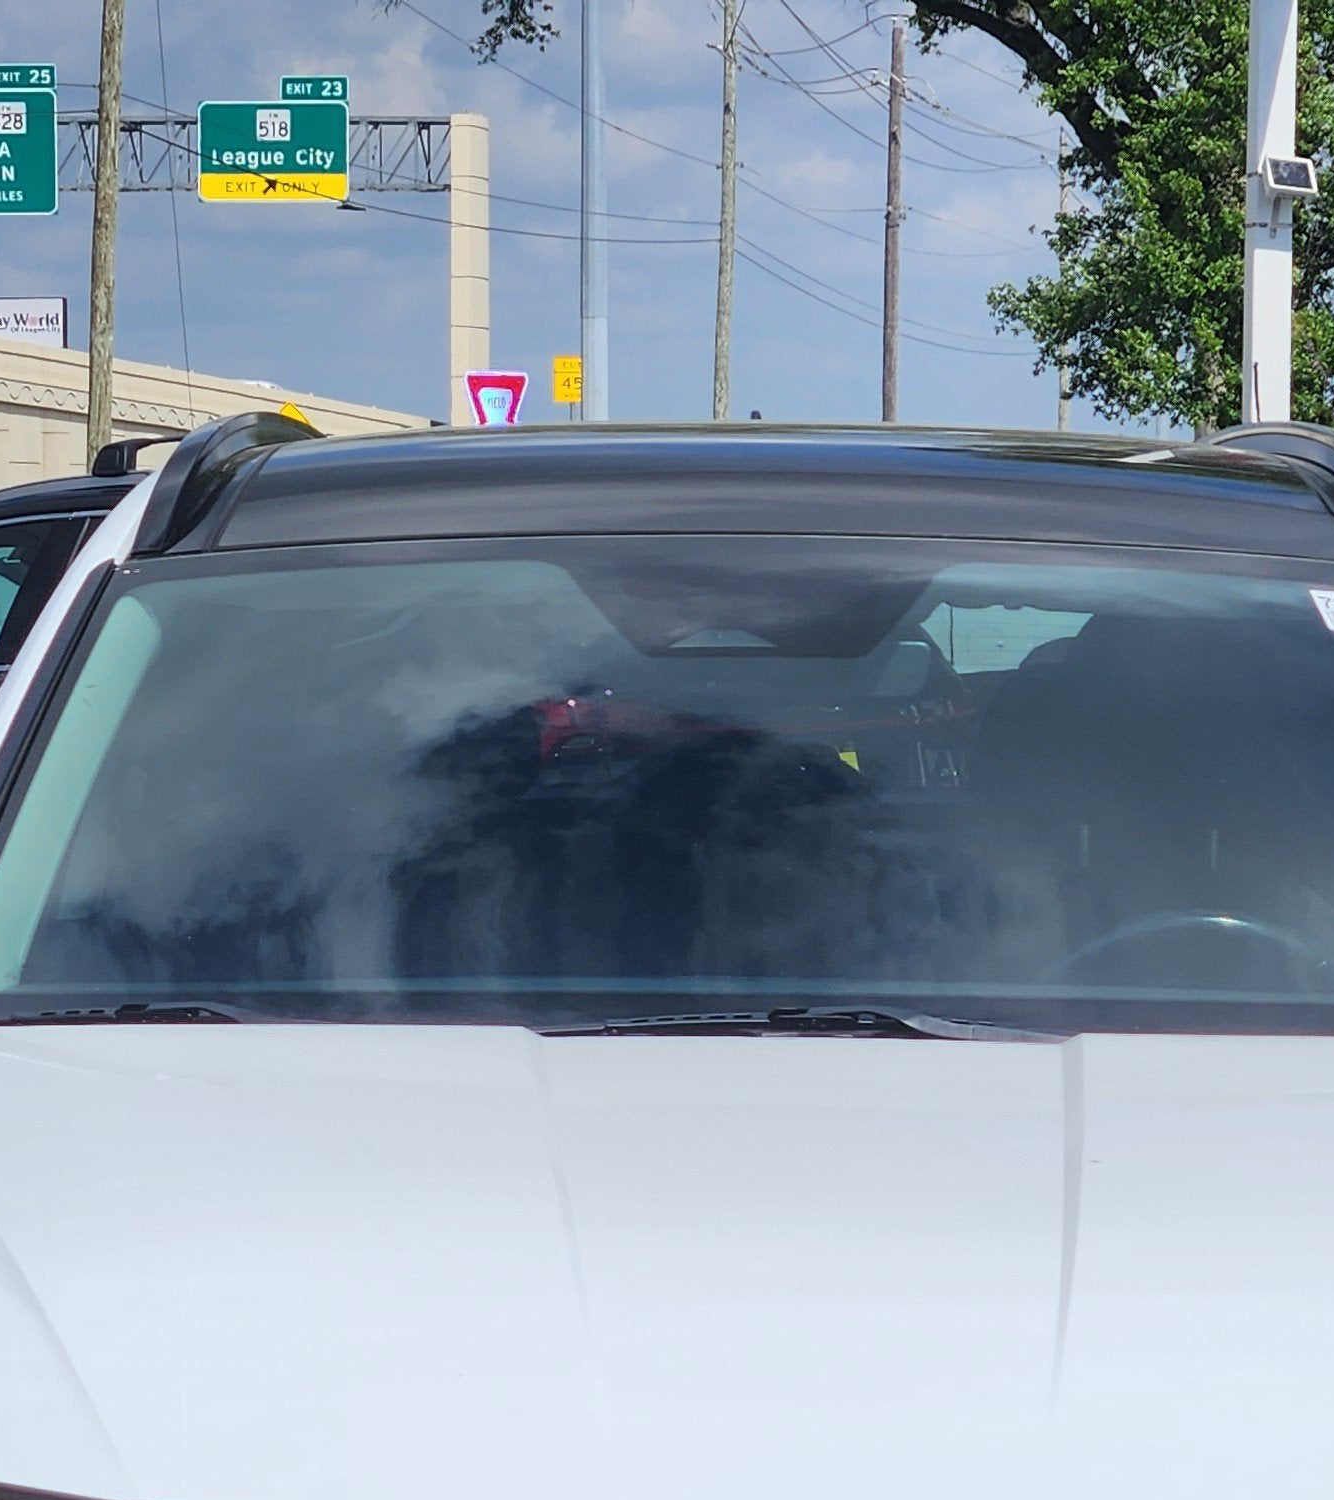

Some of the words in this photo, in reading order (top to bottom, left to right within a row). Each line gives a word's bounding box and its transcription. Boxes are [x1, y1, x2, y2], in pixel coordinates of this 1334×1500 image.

[29, 69, 51, 84] 25
[286, 83, 313, 95] EXIT
[321, 81, 343, 96] 23
[259, 121, 288, 138] 518
[212, 148, 285, 169] League
[295, 147, 335, 169] City
[225, 181, 257, 193] EXIT
[282, 181, 320, 194] ONLY
[13, 313, 59, 327] World
[562, 376, 583, 390] 45
